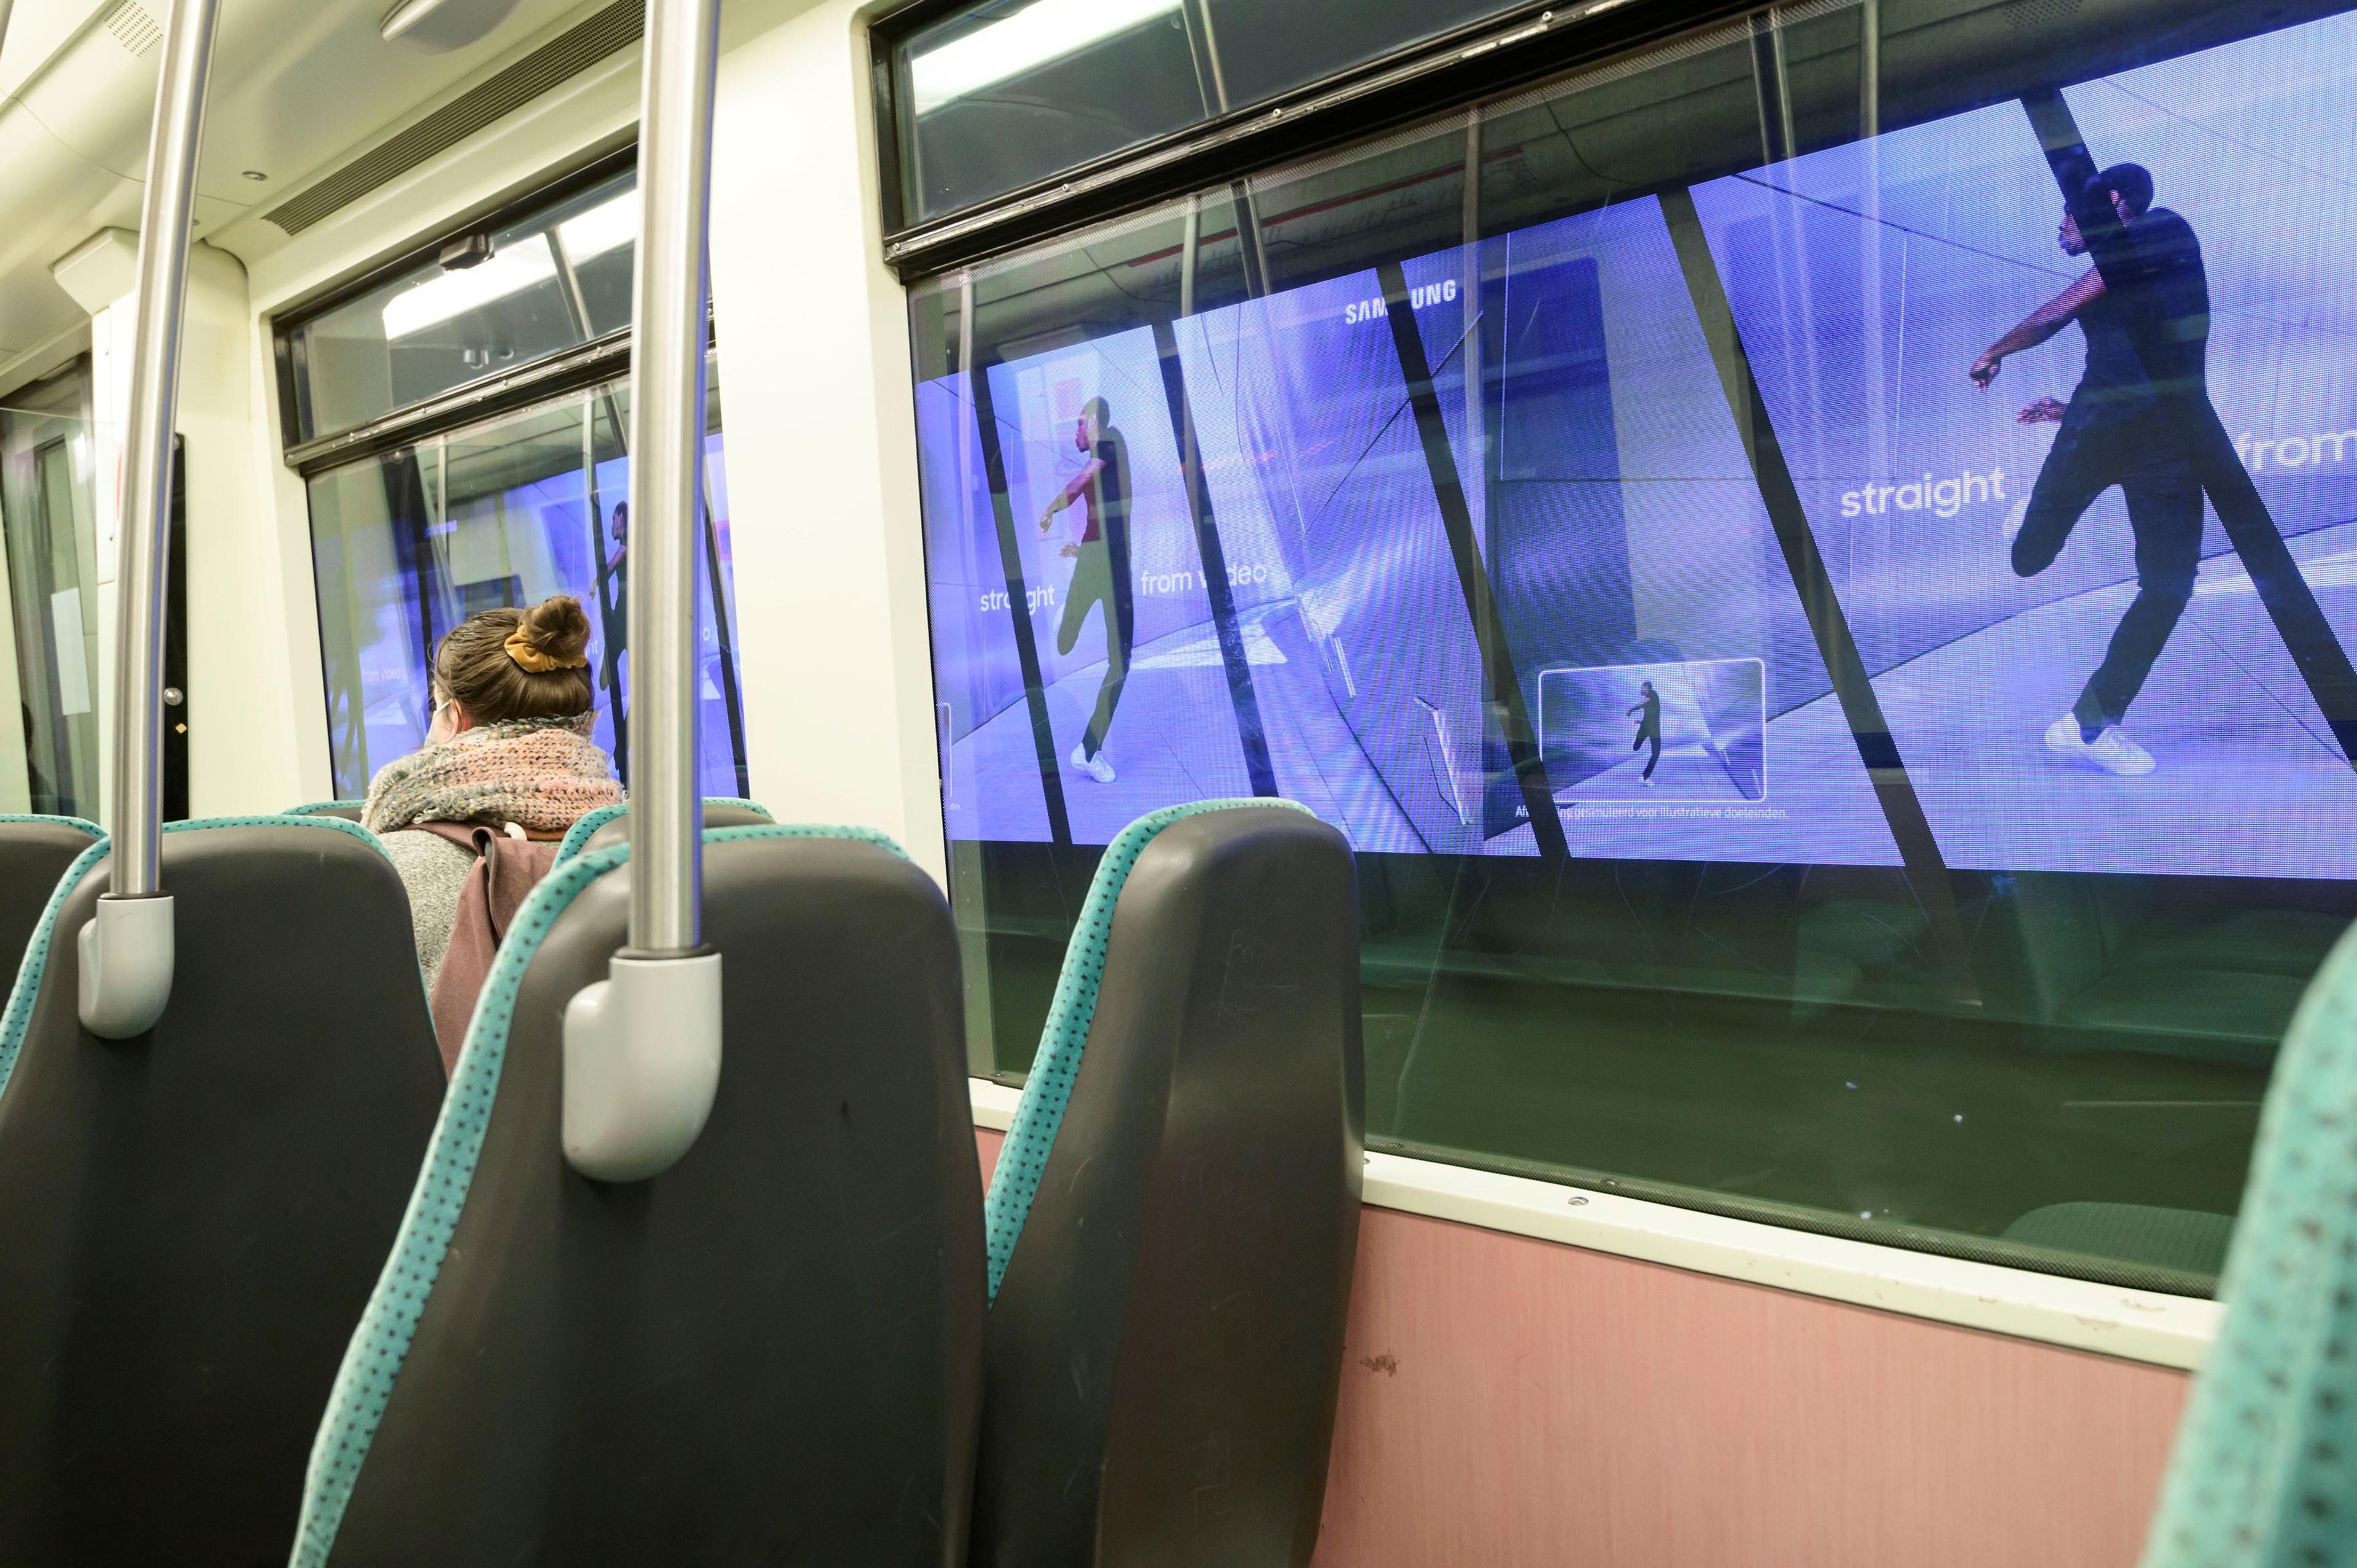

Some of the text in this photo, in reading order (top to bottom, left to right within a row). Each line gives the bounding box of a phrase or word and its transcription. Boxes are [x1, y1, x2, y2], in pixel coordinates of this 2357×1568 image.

[1345, 279, 1456, 325] SAMUNG
[1841, 466, 2006, 517] straight
[1140, 570, 1193, 596] from
[1635, 807, 1659, 821] voor
